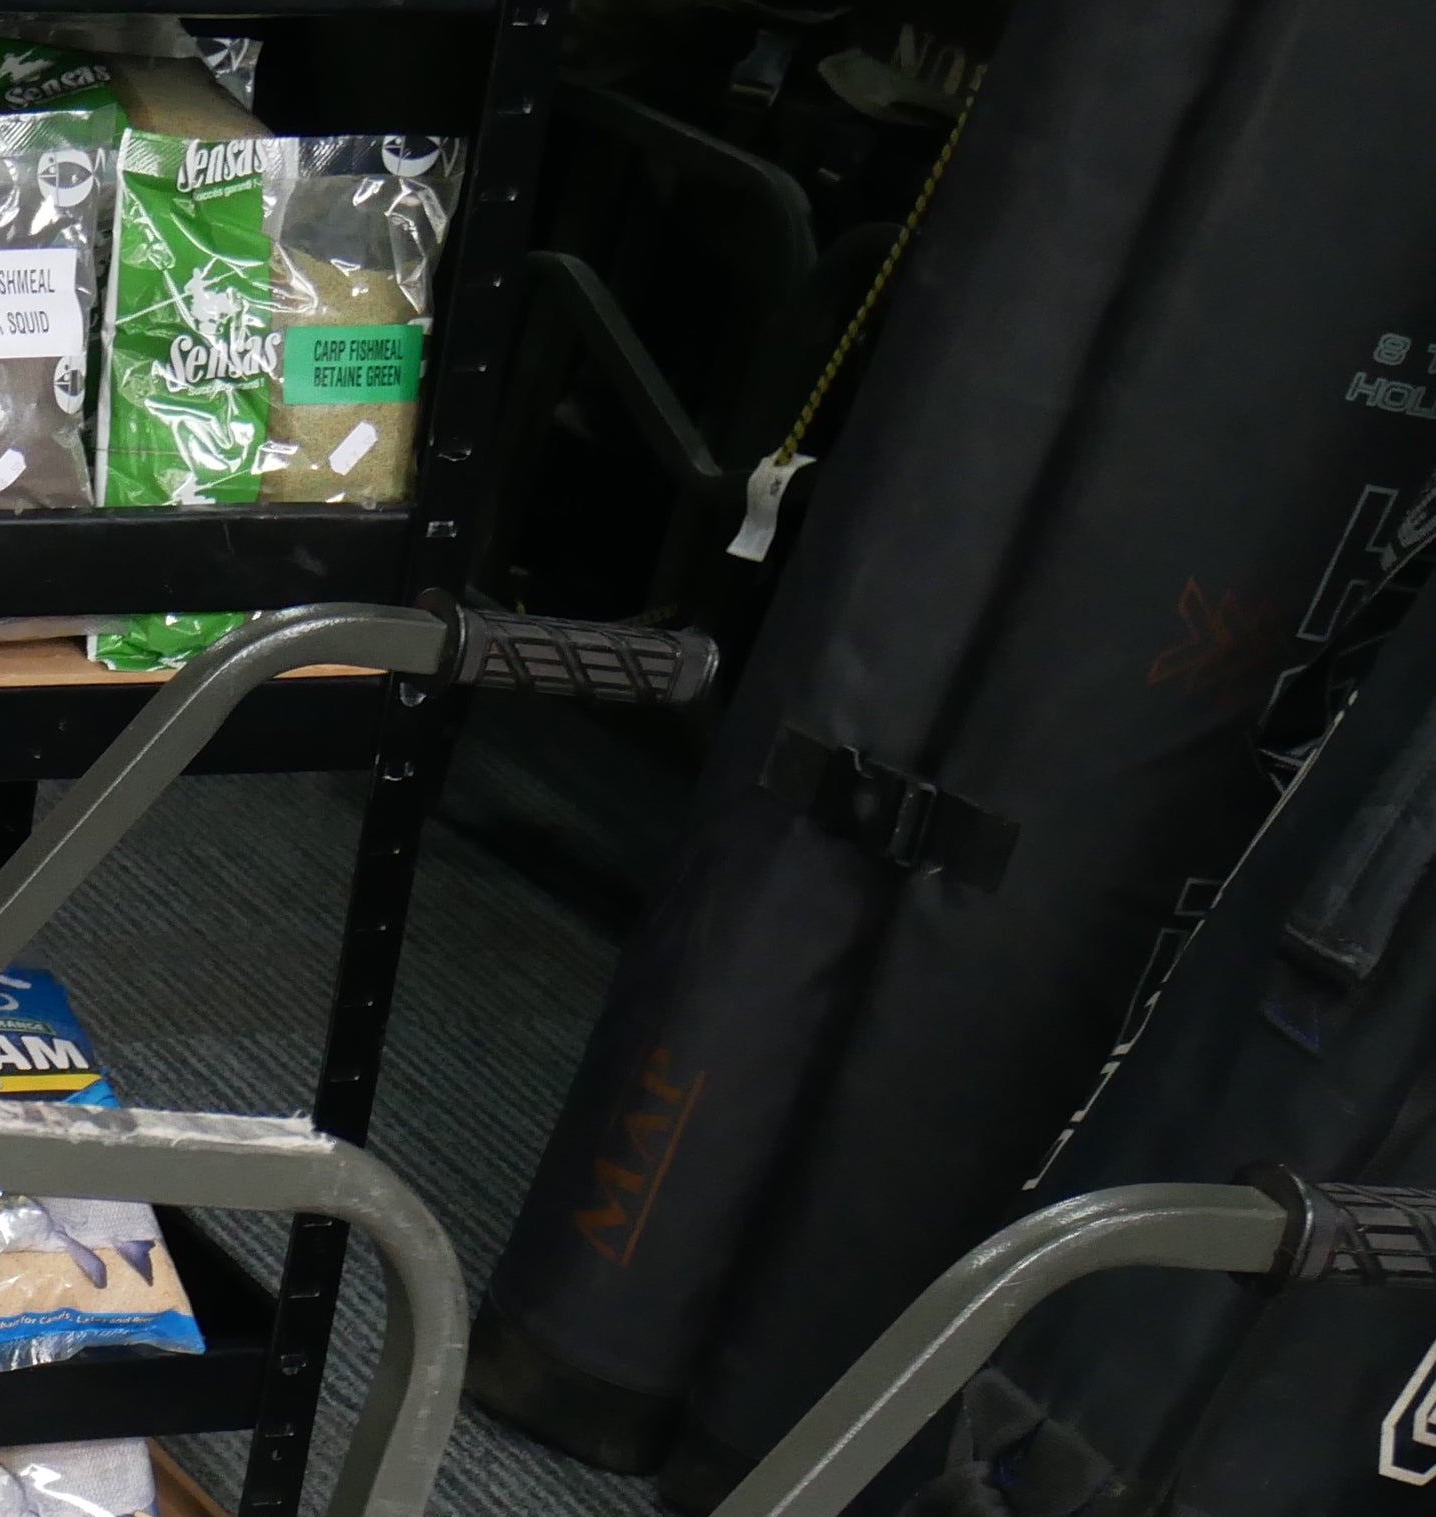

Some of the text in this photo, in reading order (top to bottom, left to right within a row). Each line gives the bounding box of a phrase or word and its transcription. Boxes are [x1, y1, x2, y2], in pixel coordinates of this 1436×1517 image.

[177, 138, 270, 192] Sensas
[7, 310, 50, 334] SQUID
[313, 338, 404, 361] CARP FISHMEAL
[1373, 332, 1412, 366] 8
[313, 364, 402, 387] BETAINE GREEN
